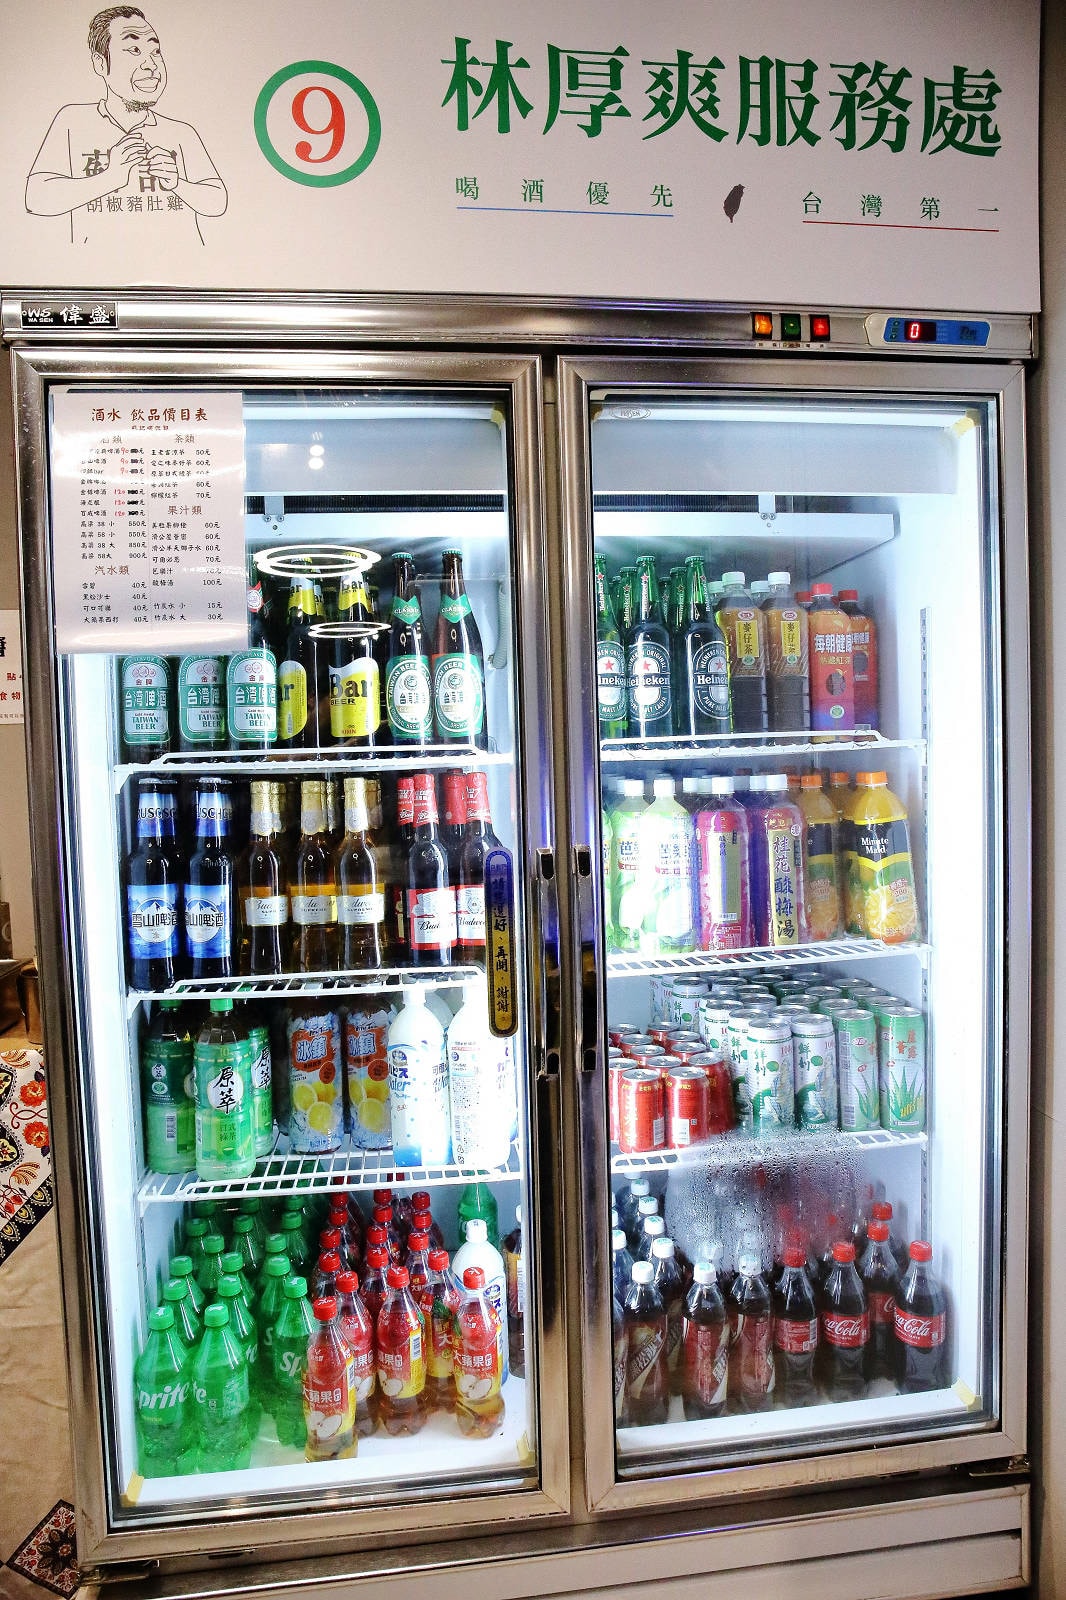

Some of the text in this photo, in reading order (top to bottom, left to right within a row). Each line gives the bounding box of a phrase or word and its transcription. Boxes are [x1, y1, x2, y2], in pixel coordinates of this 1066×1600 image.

[440, 36, 1003, 159] 林厚爽服務處
[291, 86, 343, 163] 9
[86, 195, 184, 213] 胡椒豬肚雞
[455, 176, 1000, 221] 喝酒優先 台灣第一
[60, 304, 110, 325] 偉盛
[91, 408, 208, 422] 酒水 飲品價目表
[167, 505, 203, 516] 果汁類
[95, 565, 130, 575] 汽水類
[187, 687, 220, 705] 台灣啤
[329, 674, 373, 698] Bar
[330, 698, 356, 706] BEER
[773, 836, 795, 938] 桂花酸梅湯
[212, 1066, 237, 1115] 原萃
